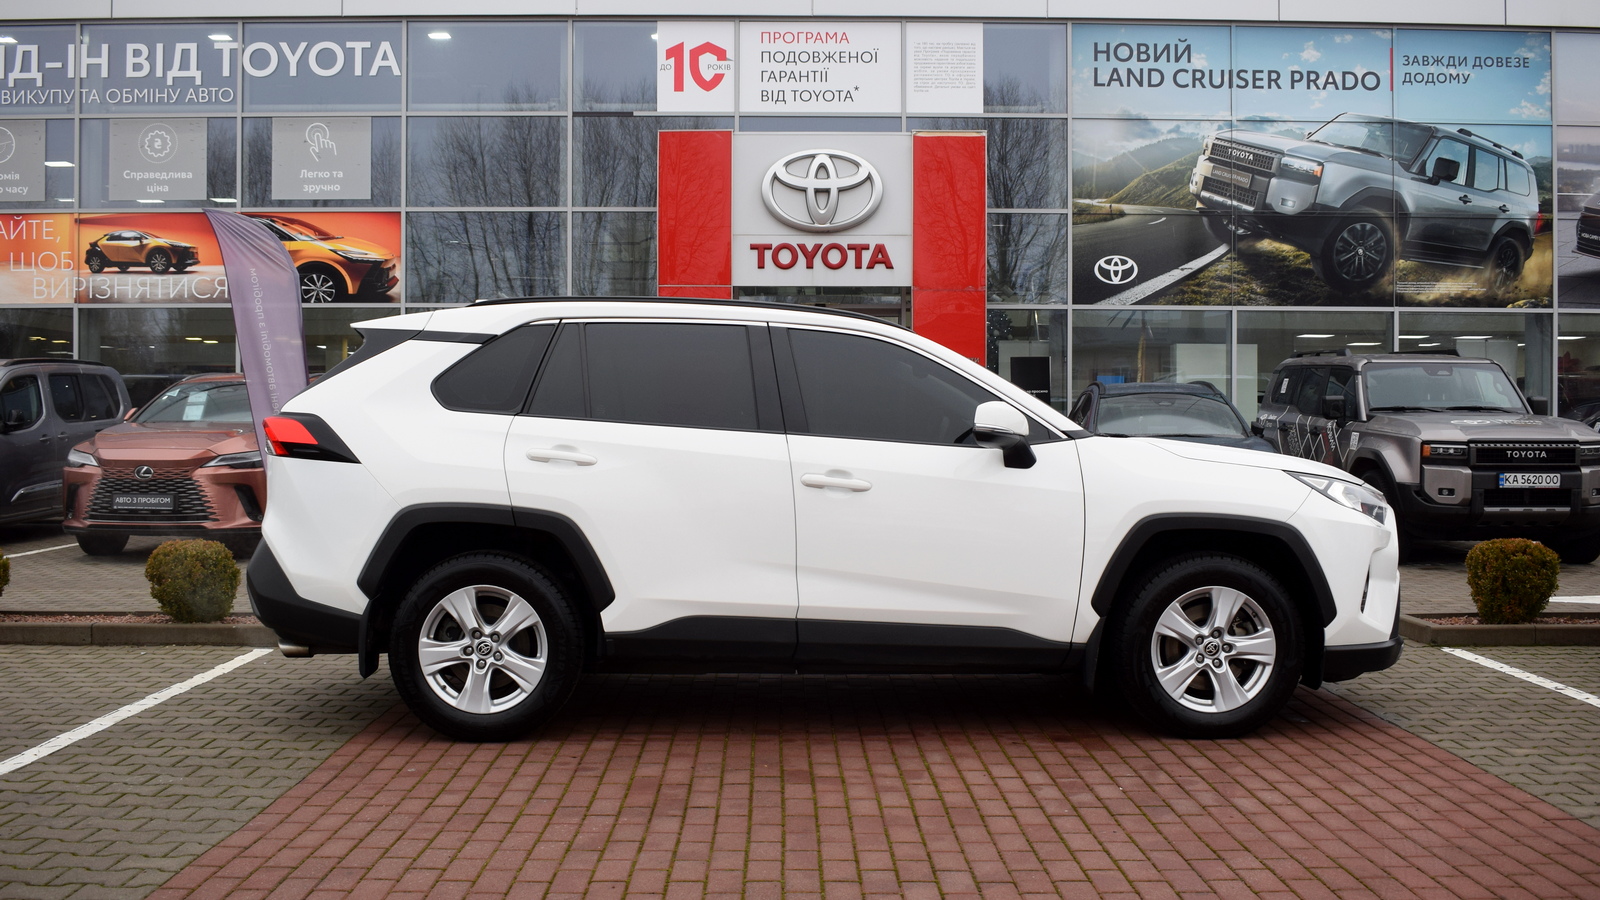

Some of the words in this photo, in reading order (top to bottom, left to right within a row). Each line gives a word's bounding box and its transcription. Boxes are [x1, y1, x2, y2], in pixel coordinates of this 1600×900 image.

[760, 31, 850, 44] ПРОГРАМА
[760, 48, 879, 66] ПОДОВЖЕНОЇ
[1093, 38, 1192, 64] НОВИЙ
[126, 42, 201, 86] ВІД
[213, 40, 402, 78] TOYOTA
[659, 63, 672, 71] ДО
[665, 41, 728, 92] 10
[707, 63, 731, 71] РОКІВ
[1402, 54, 1468, 69] ЗАВЖДИ
[1472, 56, 1530, 71] ДОВЕЗЕ
[760, 67, 829, 83] ГАРАНТІЇ
[1093, 66, 1165, 88] LAND
[1171, 67, 1282, 91] CRUISER
[1289, 70, 1381, 91] PRADO
[1402, 71, 1471, 86] ДОДОМУ
[1, 89, 74, 105] ВИКУПУ
[79, 89, 100, 104] ТА
[105, 87, 182, 104] ОБМІНУ
[185, 87, 234, 103] АВТО
[760, 89, 787, 105] ВІД
[1228, 149, 1254, 161] TOYOTA
[123, 170, 193, 182] Справедлива
[299, 169, 330, 179] Легко
[5, 186, 29, 196] часу
[146, 183, 169, 194] ціна
[303, 184, 341, 193] зручно
[10, 251, 74, 275] ЩОБ
[749, 242, 895, 270] TOYOTA
[33, 276, 228, 298] ВИРІЗНЯТИСЯ
[1506, 450, 1547, 458] TOYOTA
[1504, 474, 1519, 485] KA
[1521, 474, 1543, 485] 5620
